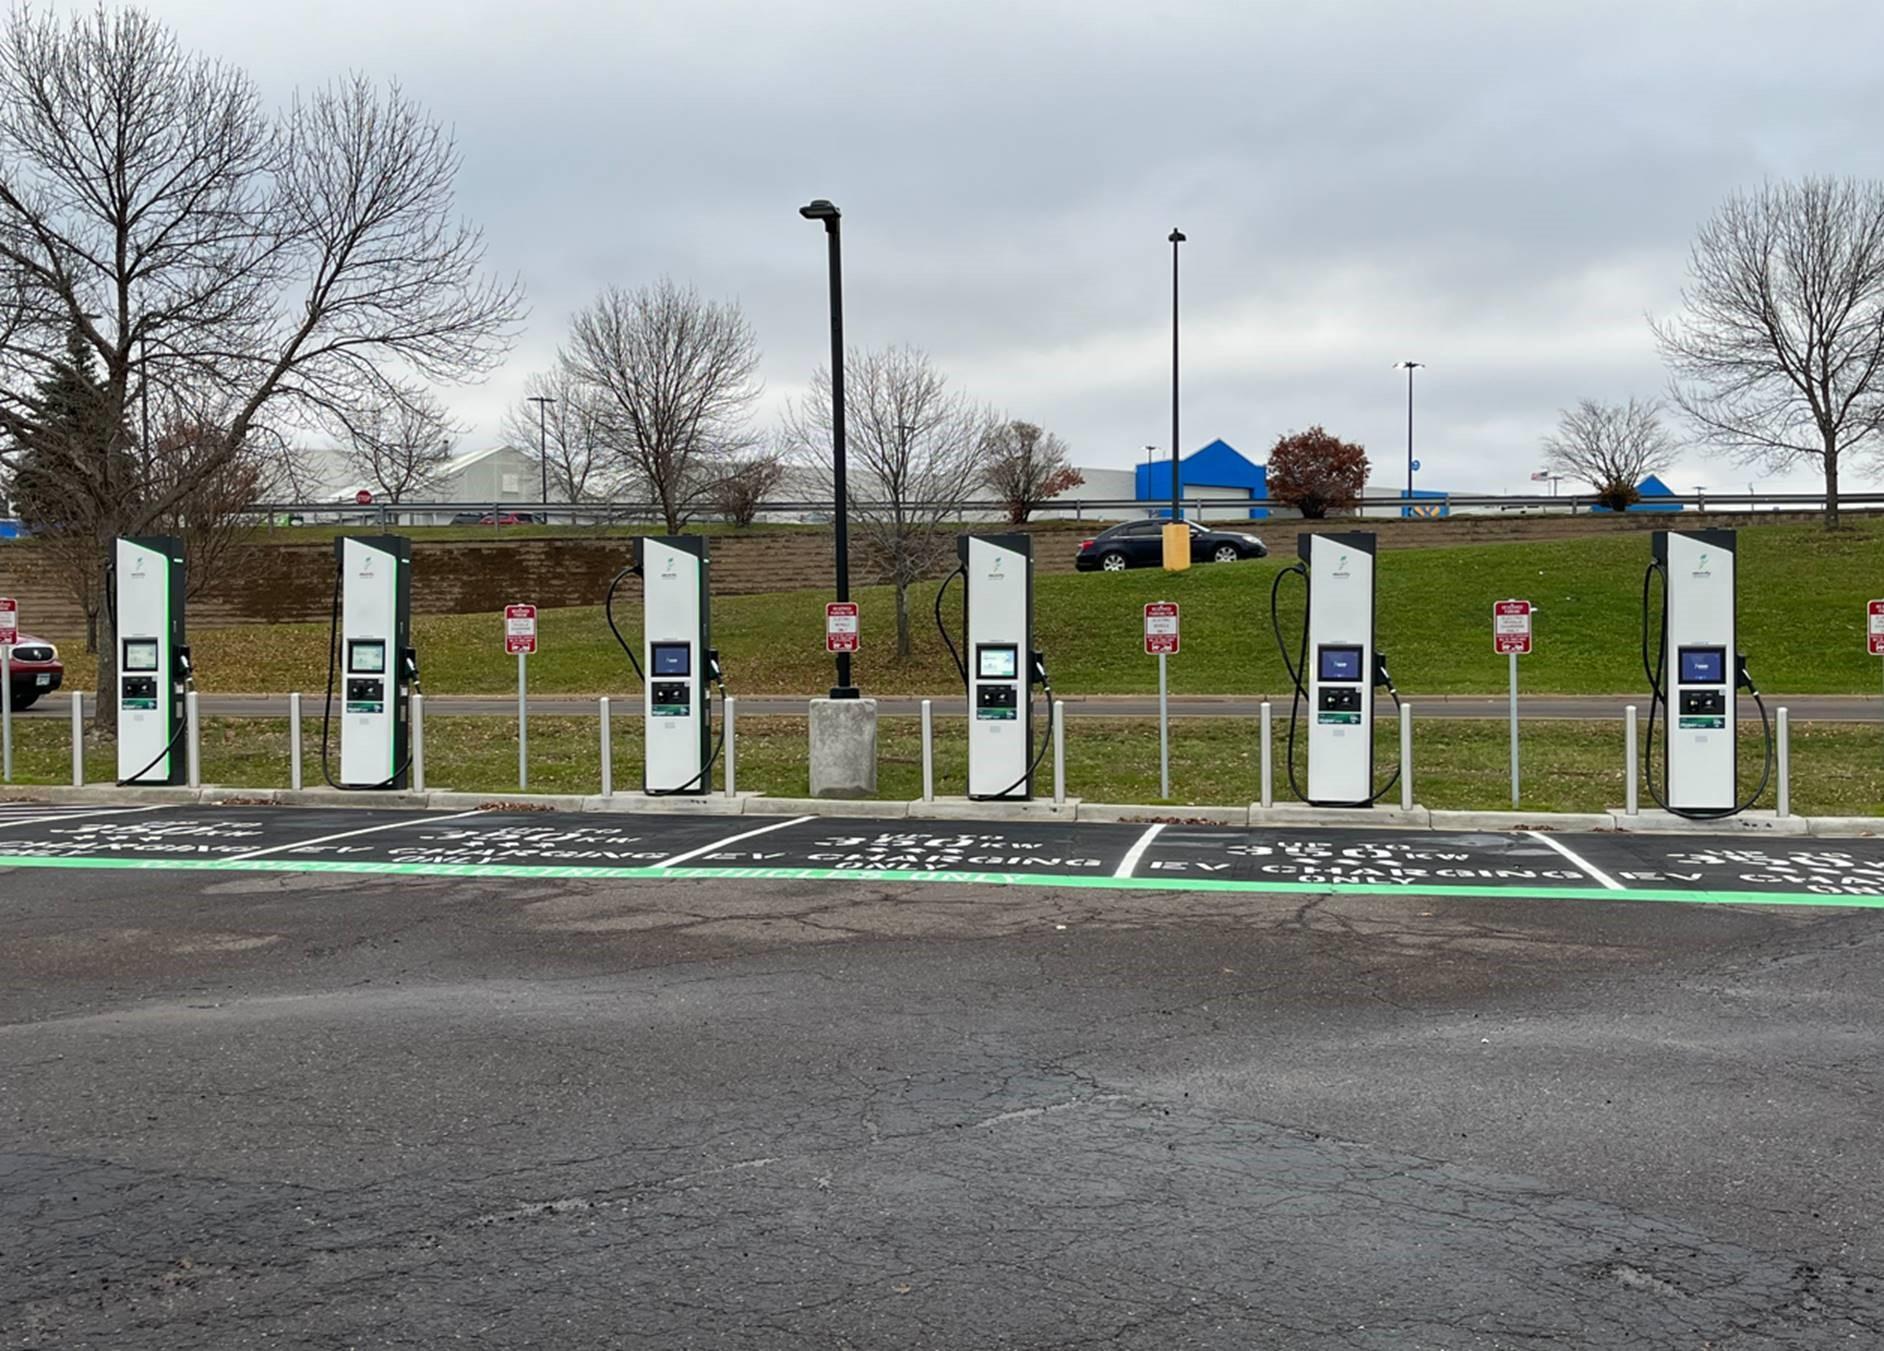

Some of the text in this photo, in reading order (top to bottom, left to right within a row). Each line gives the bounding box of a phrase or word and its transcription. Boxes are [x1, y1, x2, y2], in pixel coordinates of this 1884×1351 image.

[420, 829, 583, 841] 350
[814, 835, 976, 848] 350
[1277, 841, 1333, 849] UP
[388, 847, 670, 859] CHARGING
[1226, 845, 1393, 859] 350
[702, 852, 1103, 867] EV CHARGING
[1666, 852, 1855, 867] 350
[834, 862, 951, 871] ONLY
[1149, 860, 1584, 880] EV CHARGING
[1297, 874, 1416, 886] ONLY
[1618, 871, 1703, 881] EV
